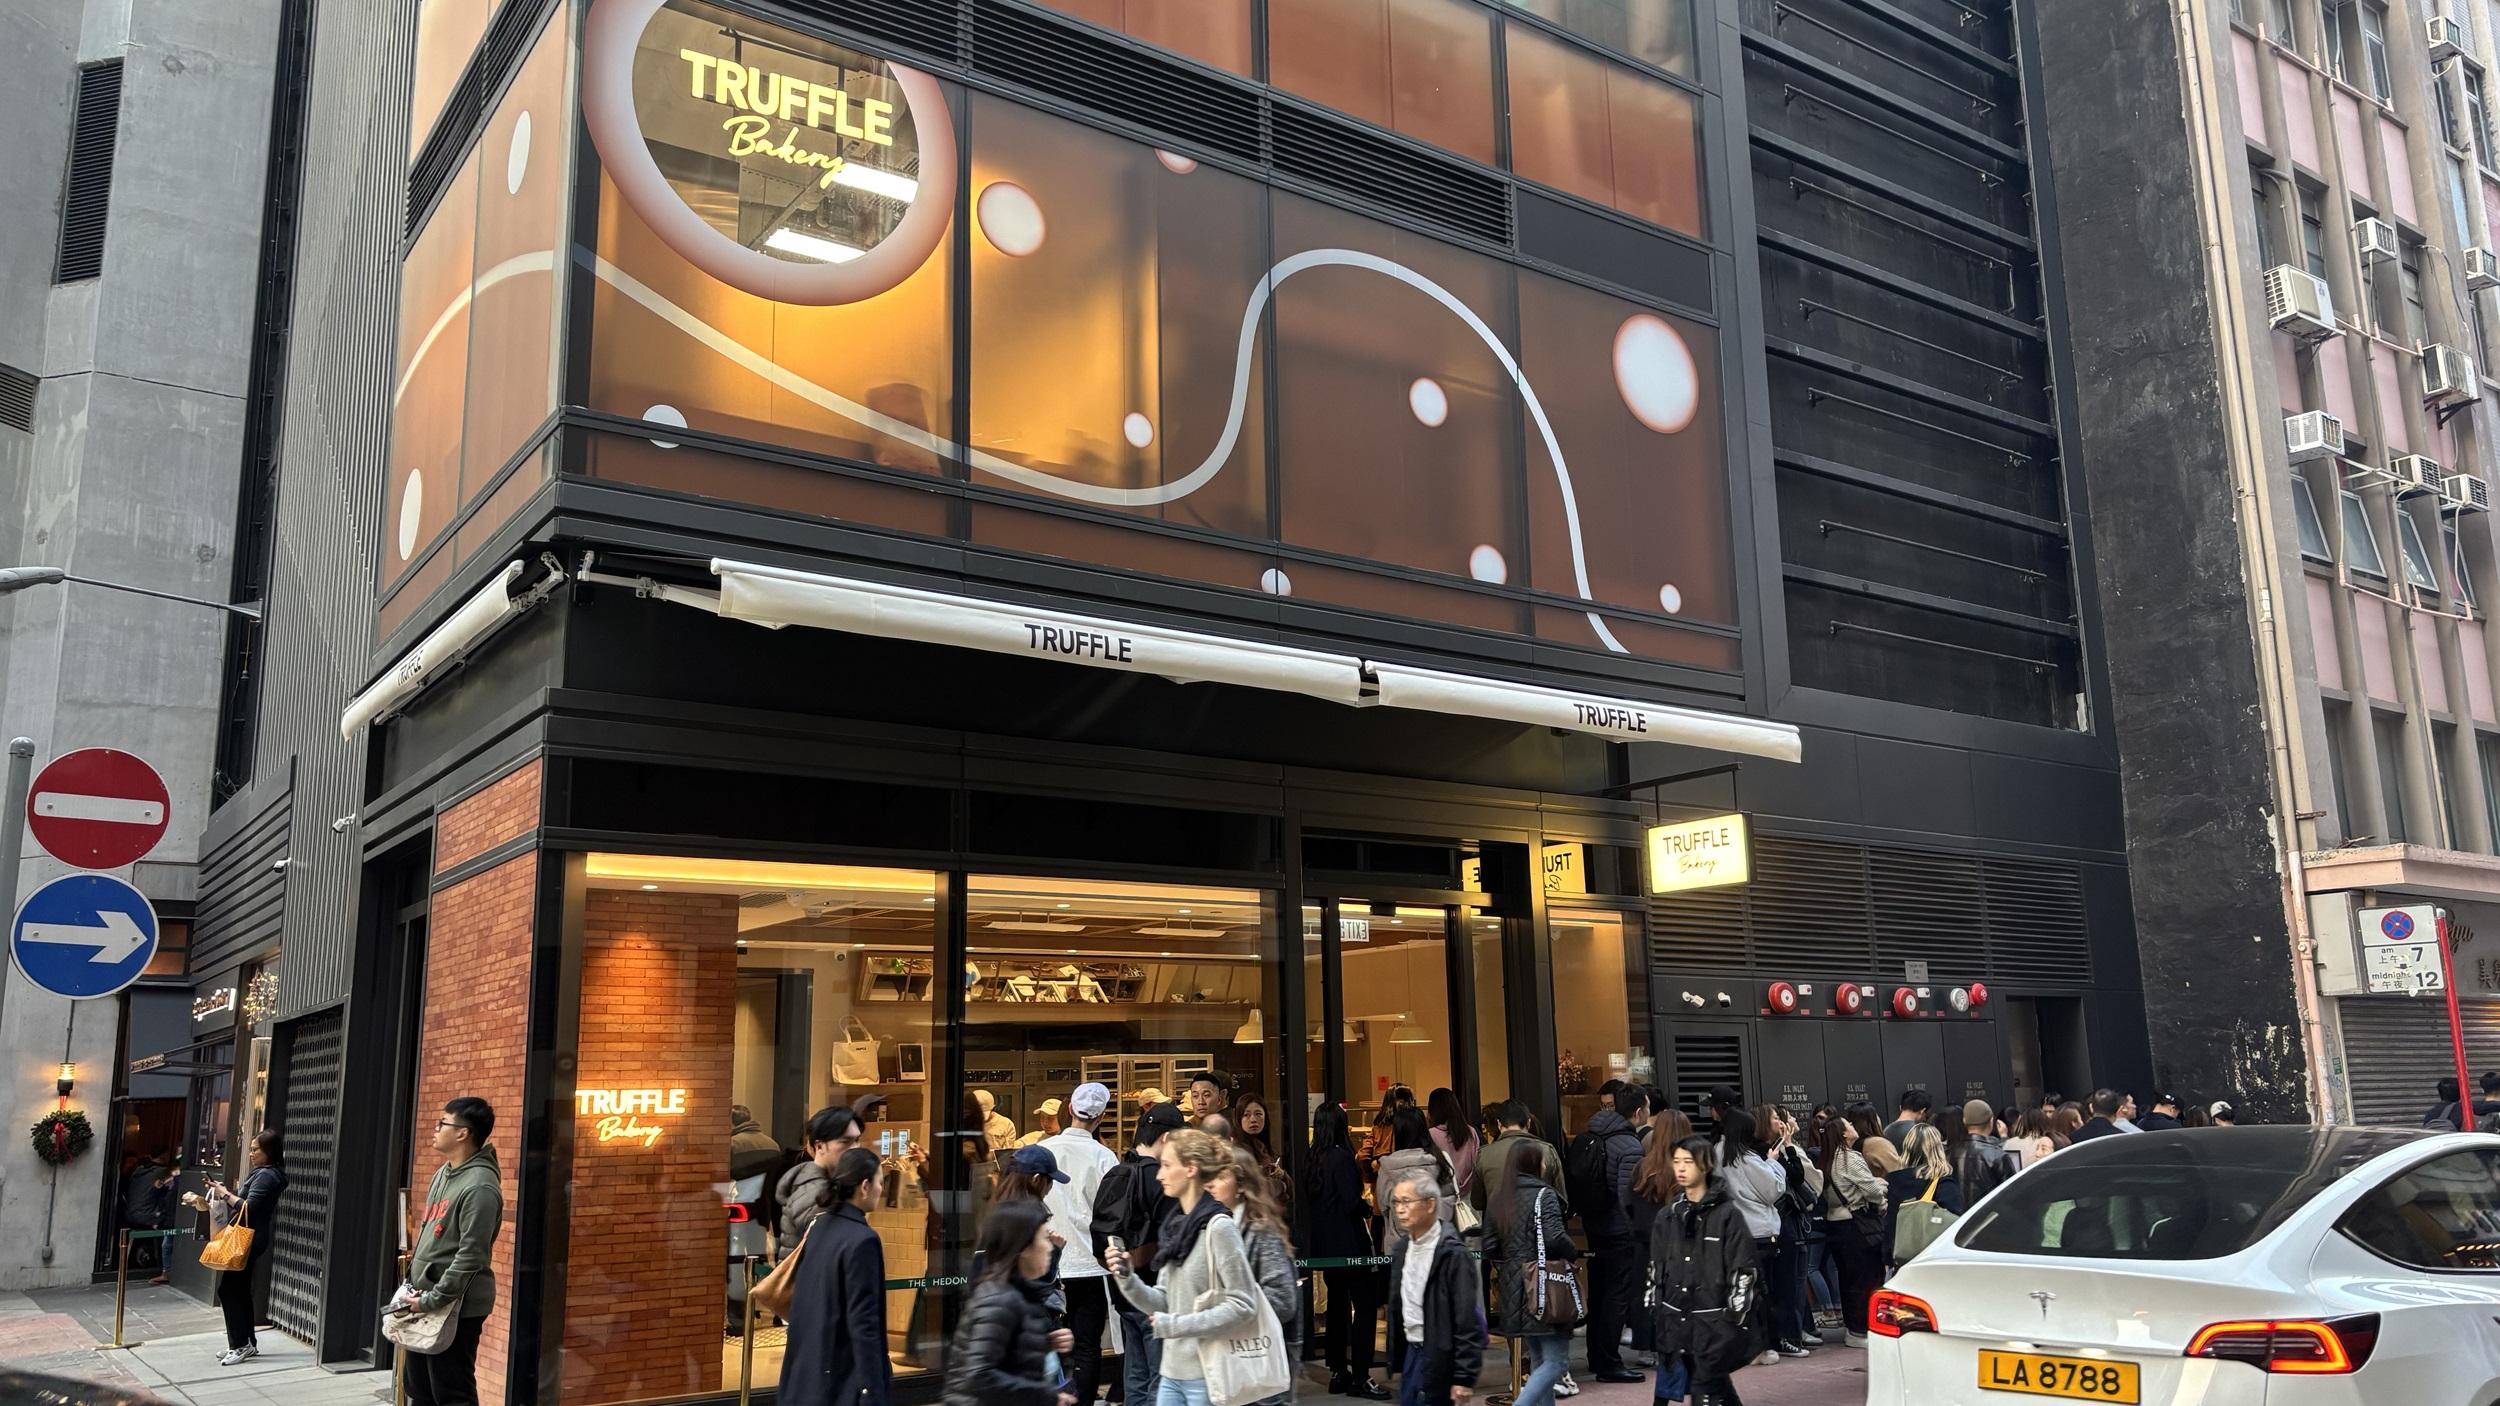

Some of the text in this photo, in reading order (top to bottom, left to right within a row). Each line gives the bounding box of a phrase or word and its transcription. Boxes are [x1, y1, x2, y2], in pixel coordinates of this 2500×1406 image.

[681, 49, 893, 146] TRUFFLE
[723, 115, 848, 189] Bakery
[1024, 623, 1133, 663] TRUFFLE
[1573, 703, 1647, 733] TRUFFLE
[1662, 828, 1730, 855] TRUFFLE
[2379, 955, 2399, 965] 上午
[2411, 947, 2423, 962] 7
[2416, 971, 2438, 987] 12
[575, 1088, 686, 1115] TRUFFLE
[595, 1116, 664, 1147] Bakery
[1295, 1259, 1308, 1268] ON
[1367, 1256, 1392, 1264] HEDO
[909, 1276, 968, 1288] THE HEDON
[1229, 1336, 1272, 1355] JALEO
[1993, 1356, 2121, 1395] LA 8788
